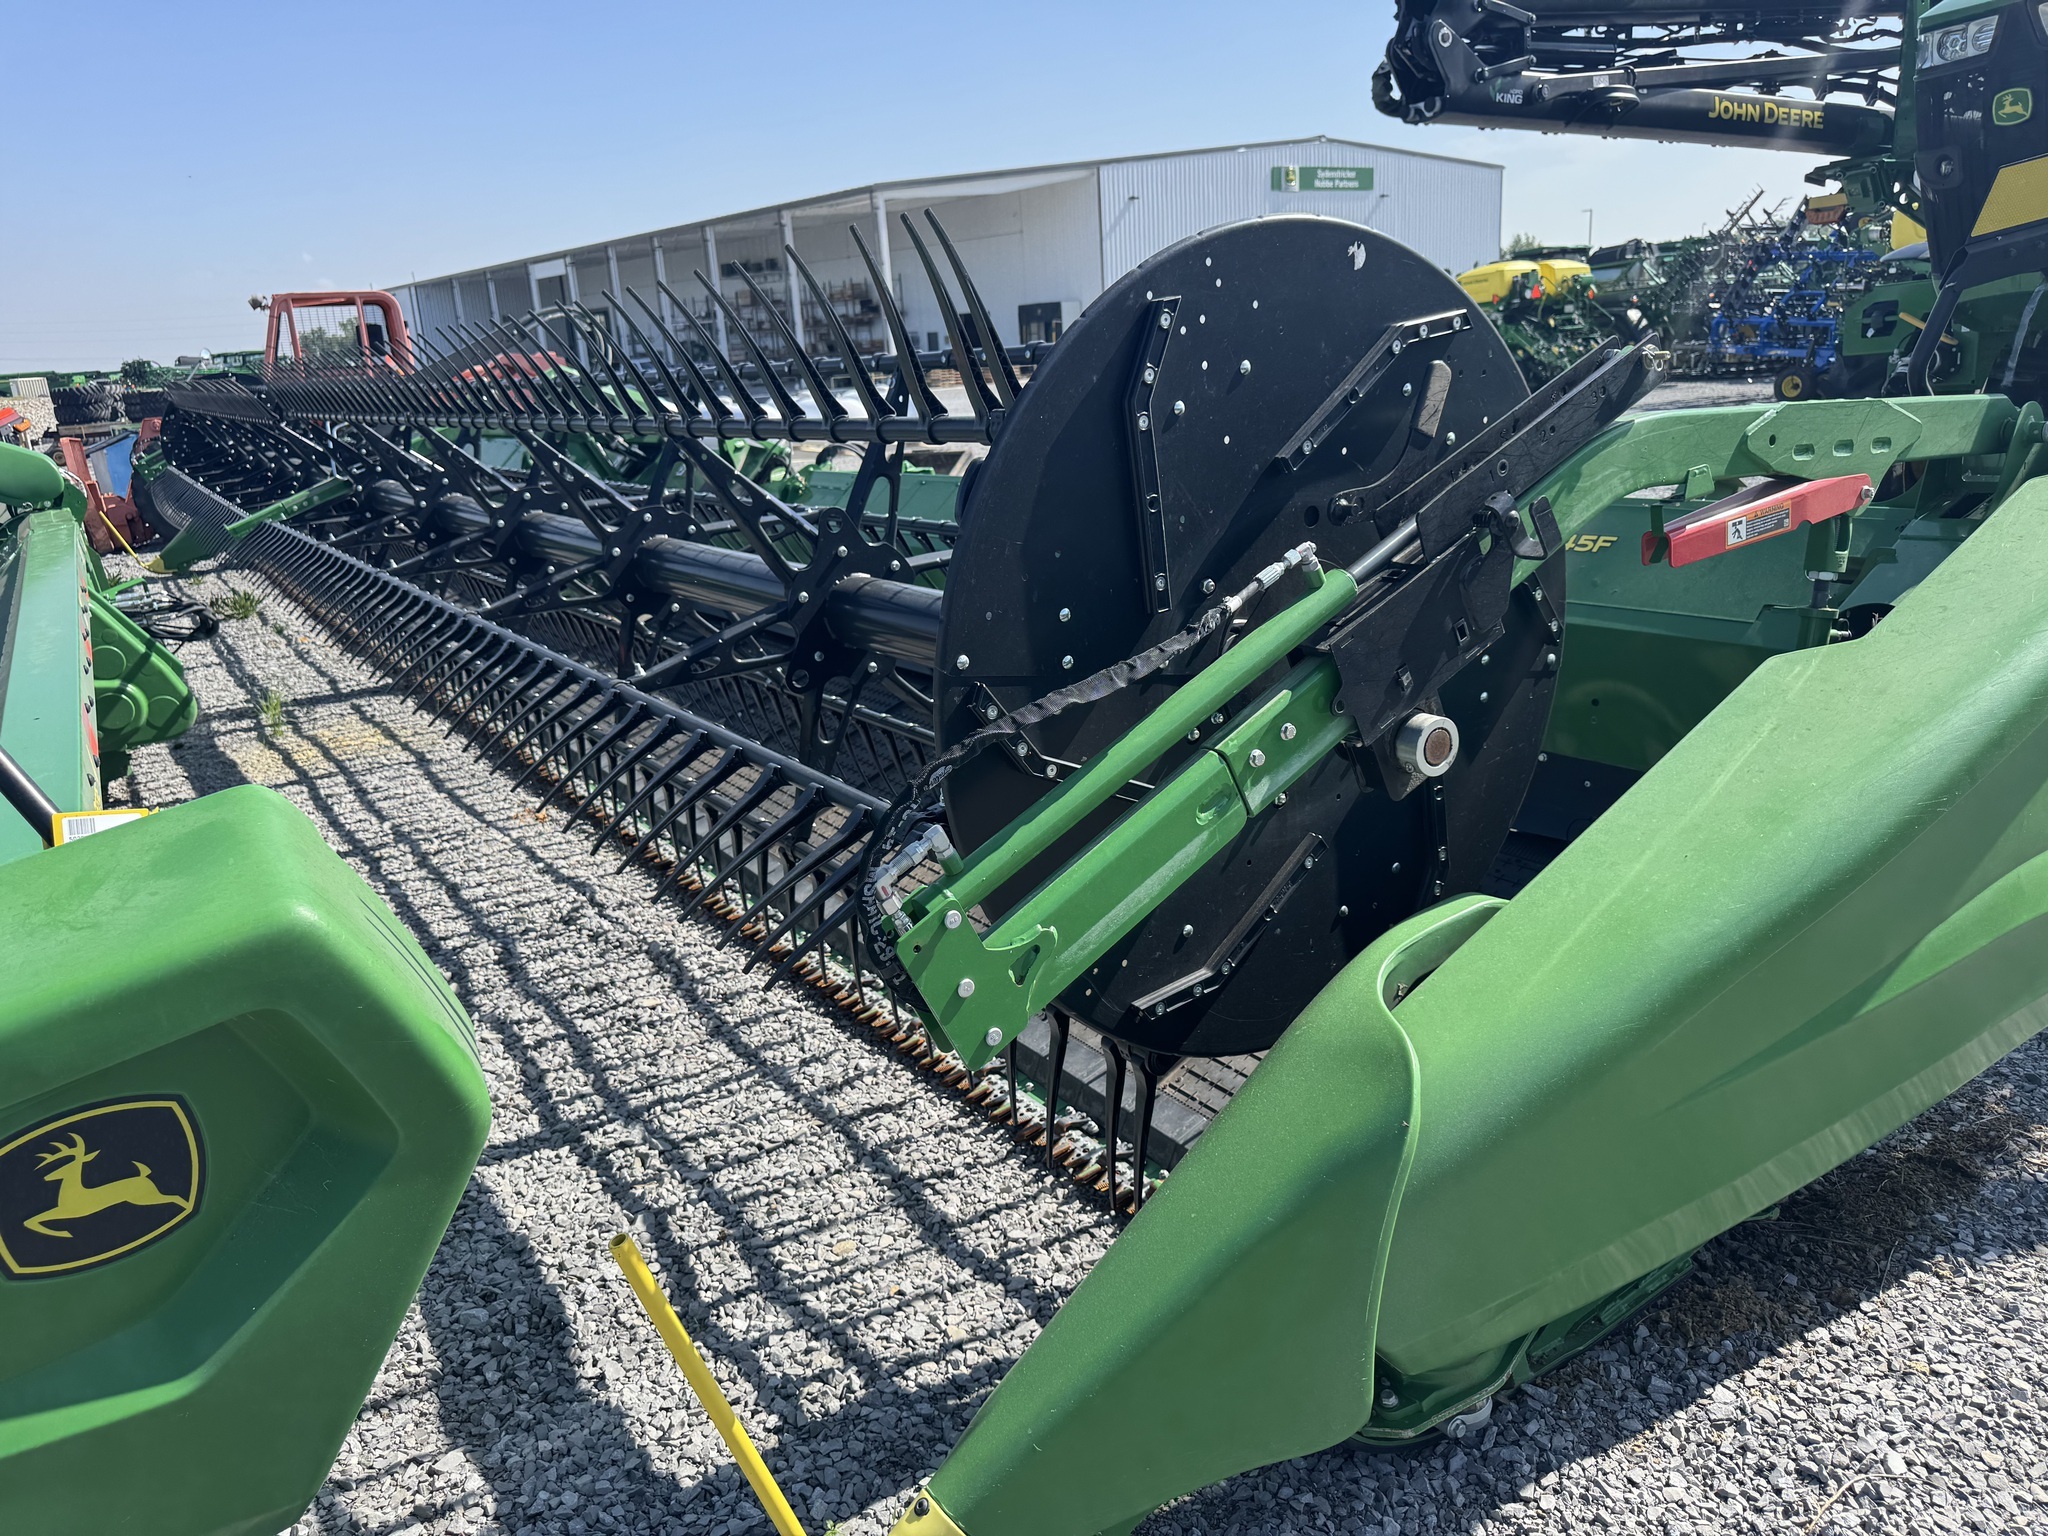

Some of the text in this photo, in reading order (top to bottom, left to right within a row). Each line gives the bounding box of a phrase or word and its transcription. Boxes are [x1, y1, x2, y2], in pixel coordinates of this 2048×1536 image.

[1496, 93, 1523, 104] KING
[1708, 95, 1824, 129] JOHN DEERE
[1335, 180, 1358, 188] Partners
[1760, 503, 1784, 515] WARNING
